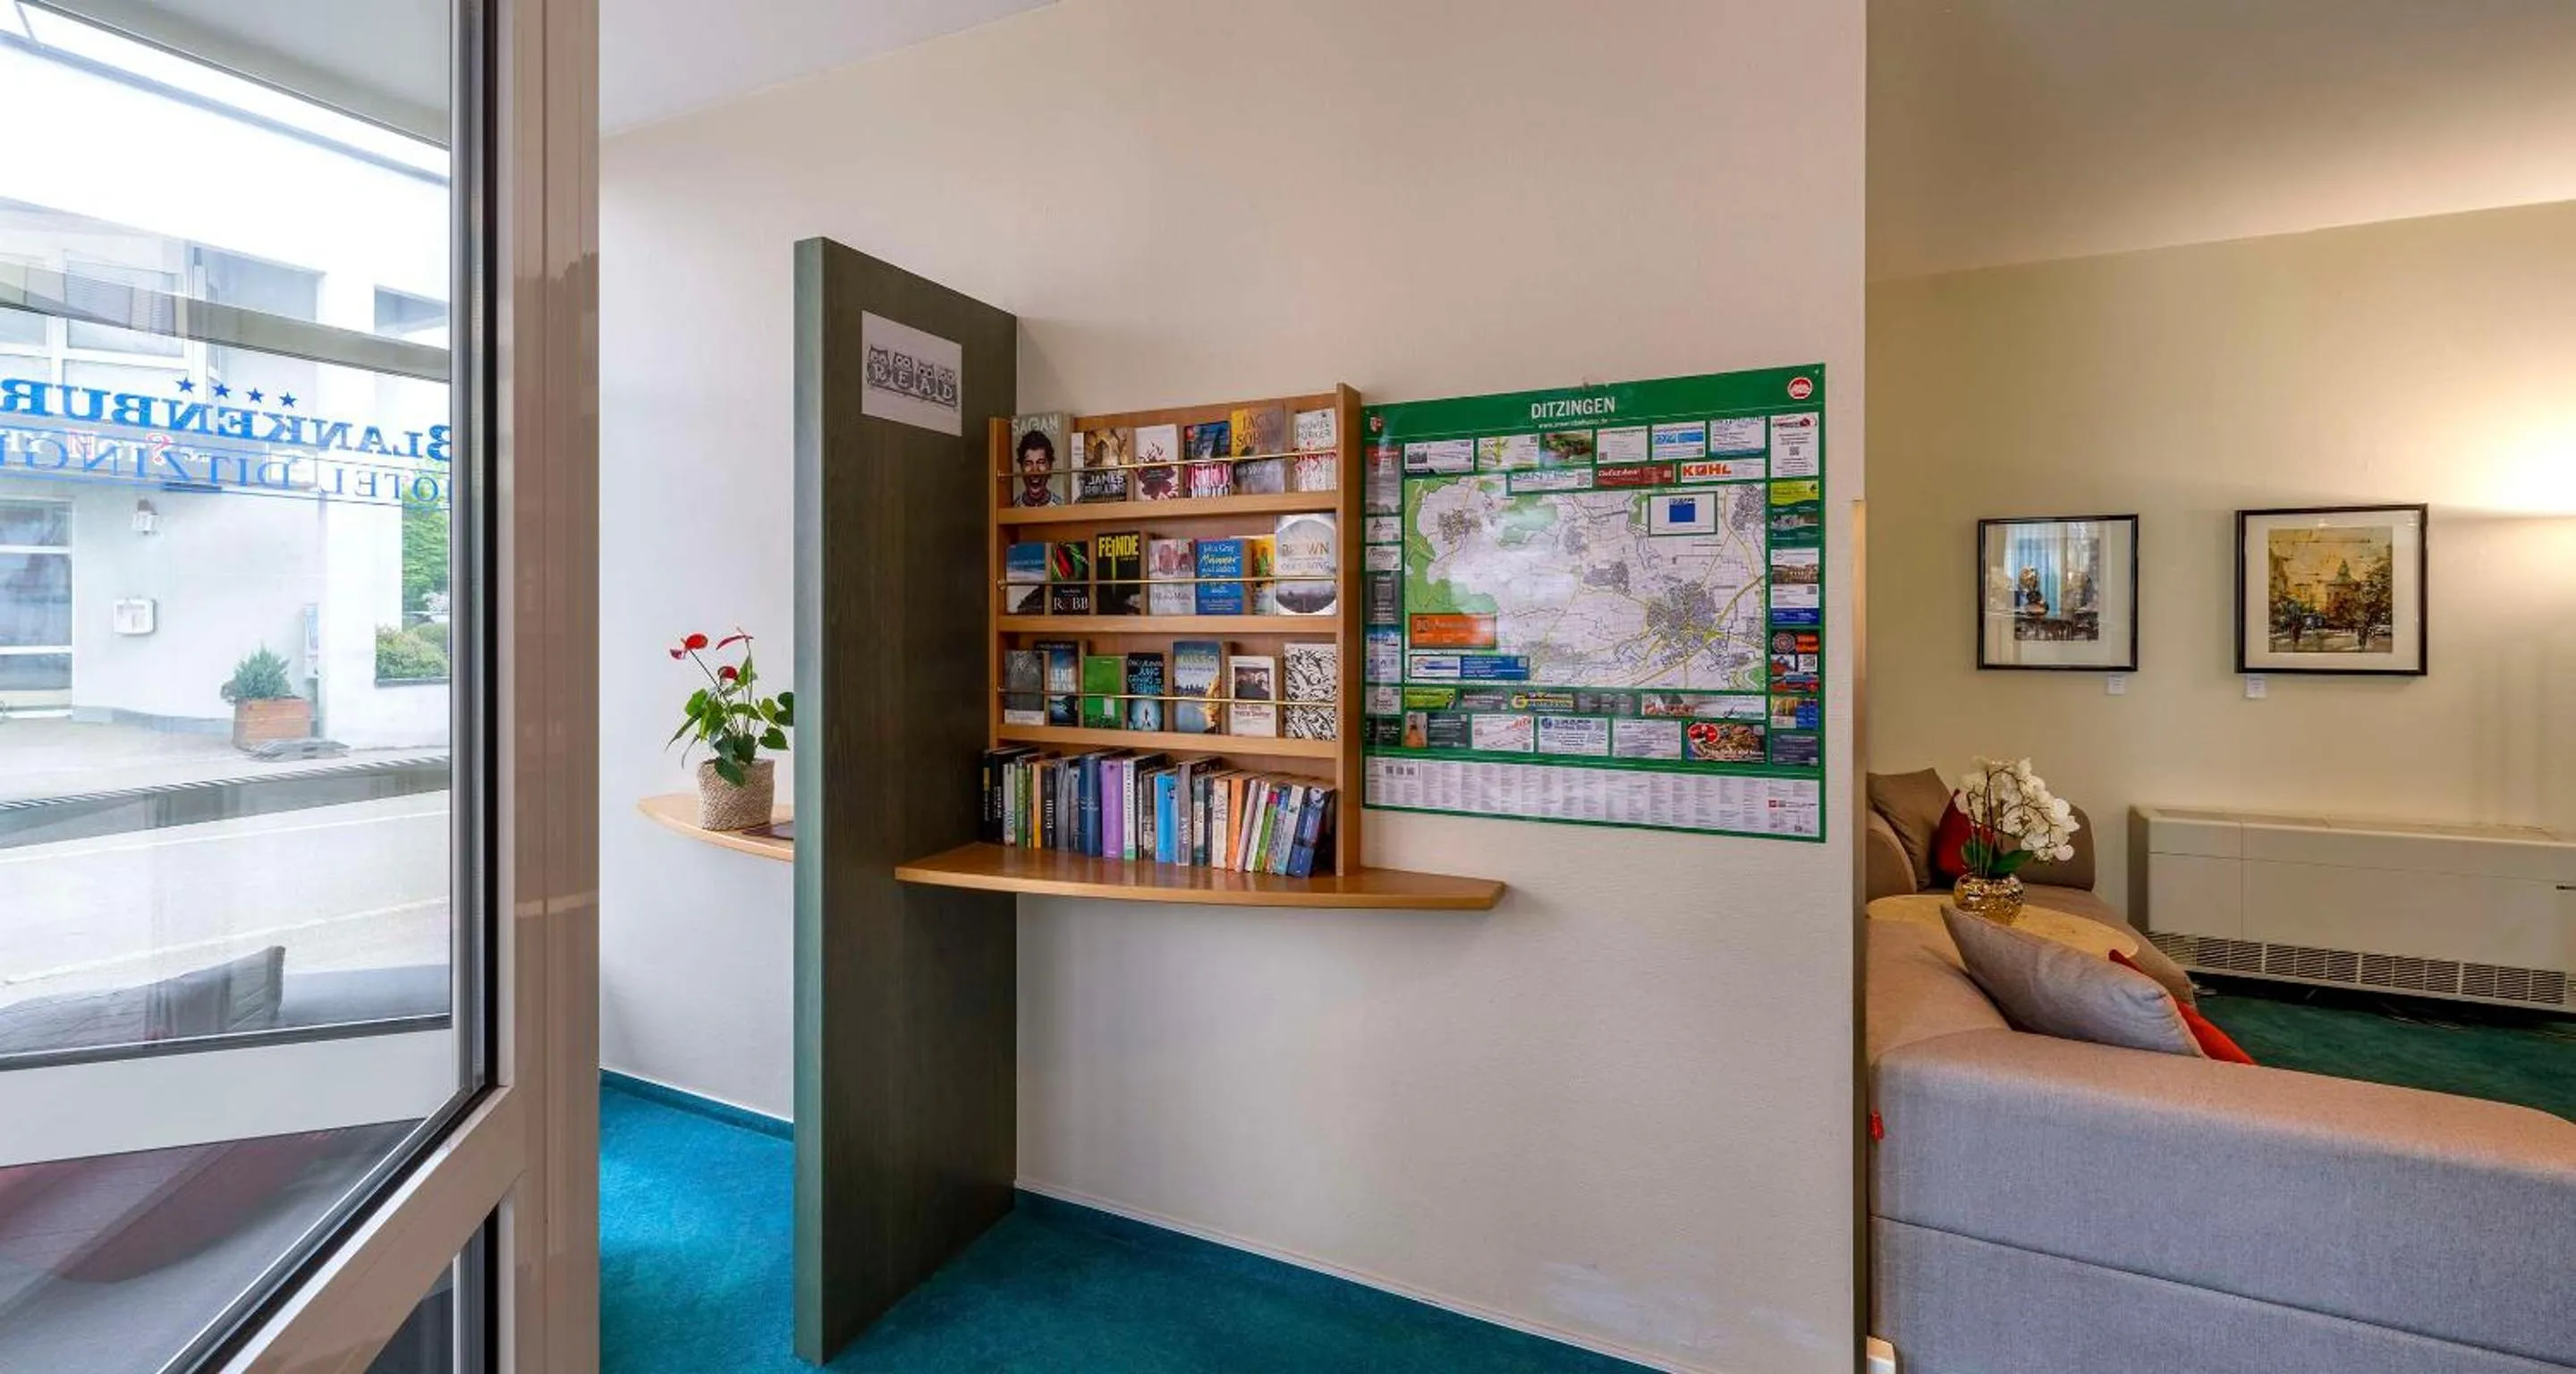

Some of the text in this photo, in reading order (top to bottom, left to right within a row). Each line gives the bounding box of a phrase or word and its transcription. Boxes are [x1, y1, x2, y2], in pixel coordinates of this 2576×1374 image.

[1530, 396, 1615, 419] DITZINGEN
[1012, 414, 1060, 435] SAGAN
[1089, 473, 1124, 485] JAMES
[1097, 534, 1140, 558] FEINDE
[1054, 597, 1089, 611] RBB
